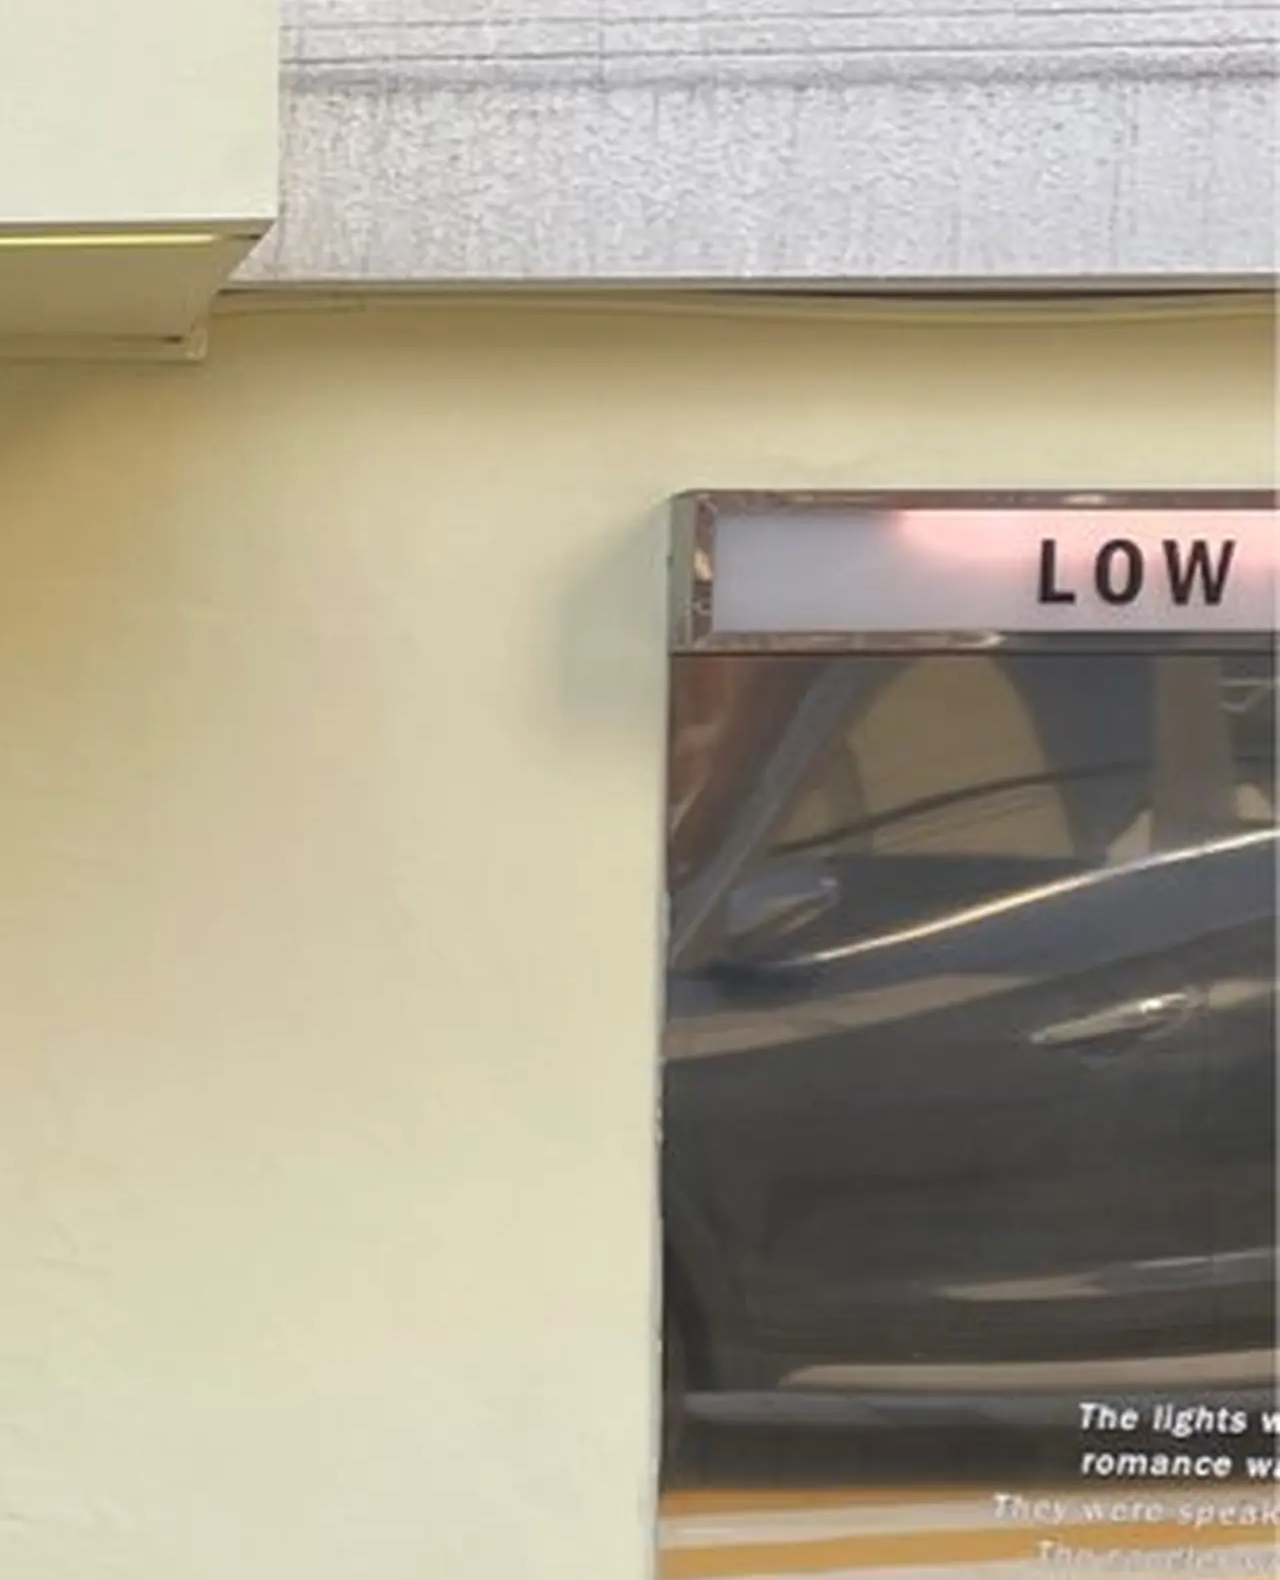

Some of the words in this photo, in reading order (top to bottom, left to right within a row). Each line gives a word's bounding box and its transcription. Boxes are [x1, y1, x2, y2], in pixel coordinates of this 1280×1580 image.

[1037, 537, 1237, 607] LOW
[1079, 1402, 1140, 1431] The
[1153, 1403, 1248, 1439] lights
[1081, 1451, 1233, 1479] romance
[993, 1493, 1068, 1525] They
[1081, 1498, 1164, 1522] were
